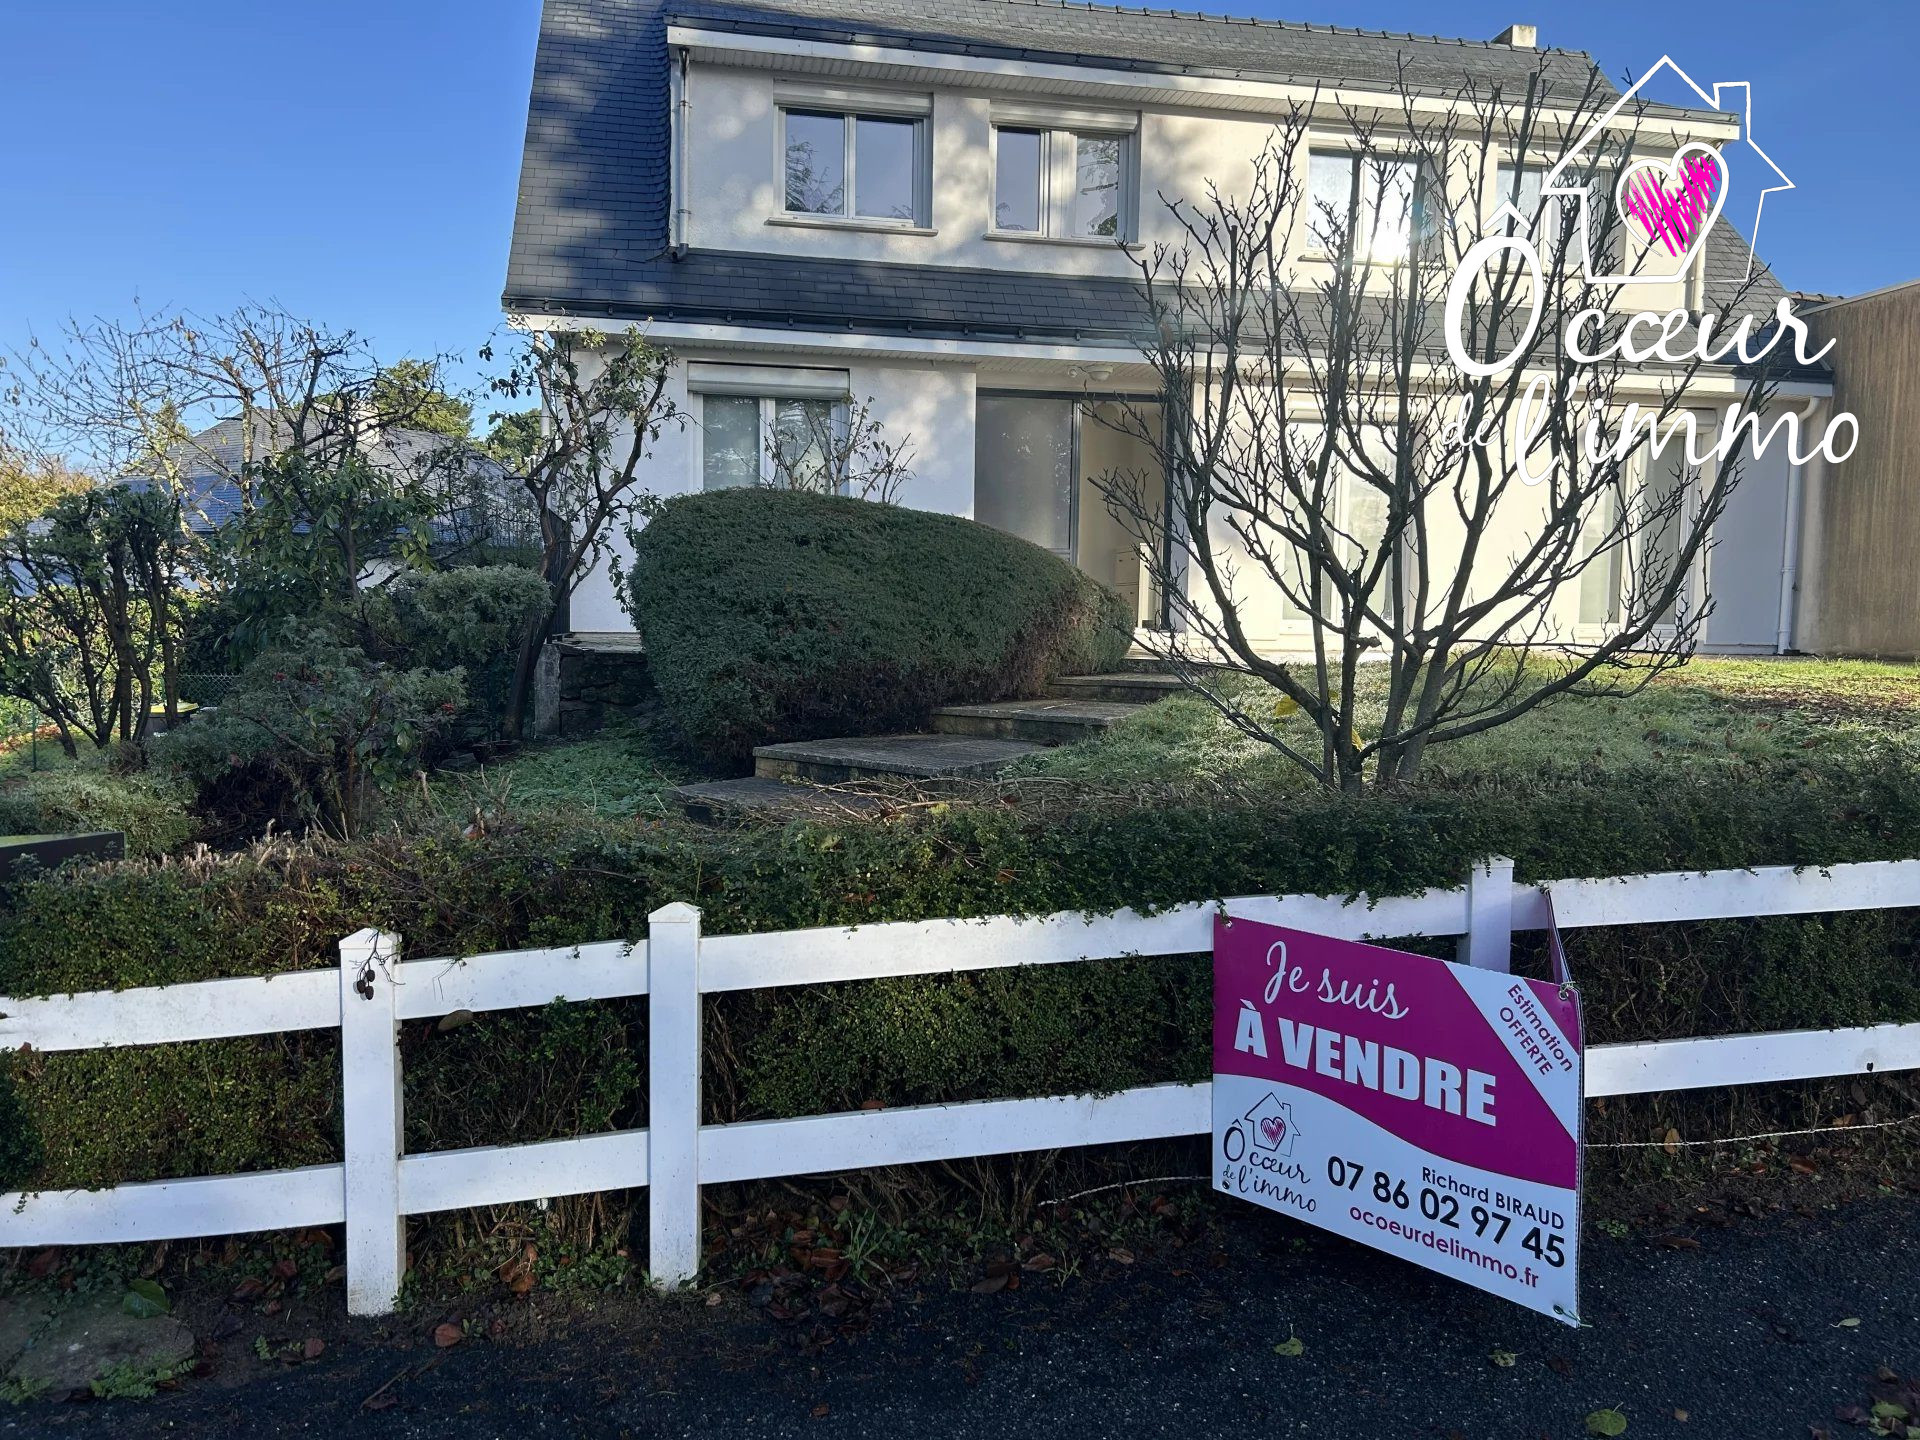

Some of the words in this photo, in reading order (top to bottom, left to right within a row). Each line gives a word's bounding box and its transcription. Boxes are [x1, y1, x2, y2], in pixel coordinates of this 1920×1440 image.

[1264, 941, 1309, 1004] Je
[1317, 968, 1409, 1020] suis
[1234, 999, 1268, 1058] À
[1278, 1017, 1496, 1126] VENDRE
[1499, 1007, 1553, 1075] OFFERTE
[1507, 984, 1573, 1072] Estimation
[1327, 1156, 1364, 1192] 07
[1372, 1173, 1410, 1210] 86
[1420, 1187, 1460, 1229] 02
[1472, 1207, 1512, 1245] 97
[1521, 1226, 1565, 1267] 45
[1422, 1166, 1489, 1204] Richard
[1495, 1194, 1564, 1230] BIRAUD
[1349, 1206, 1539, 1288] ocoeurdelimmo.fr
